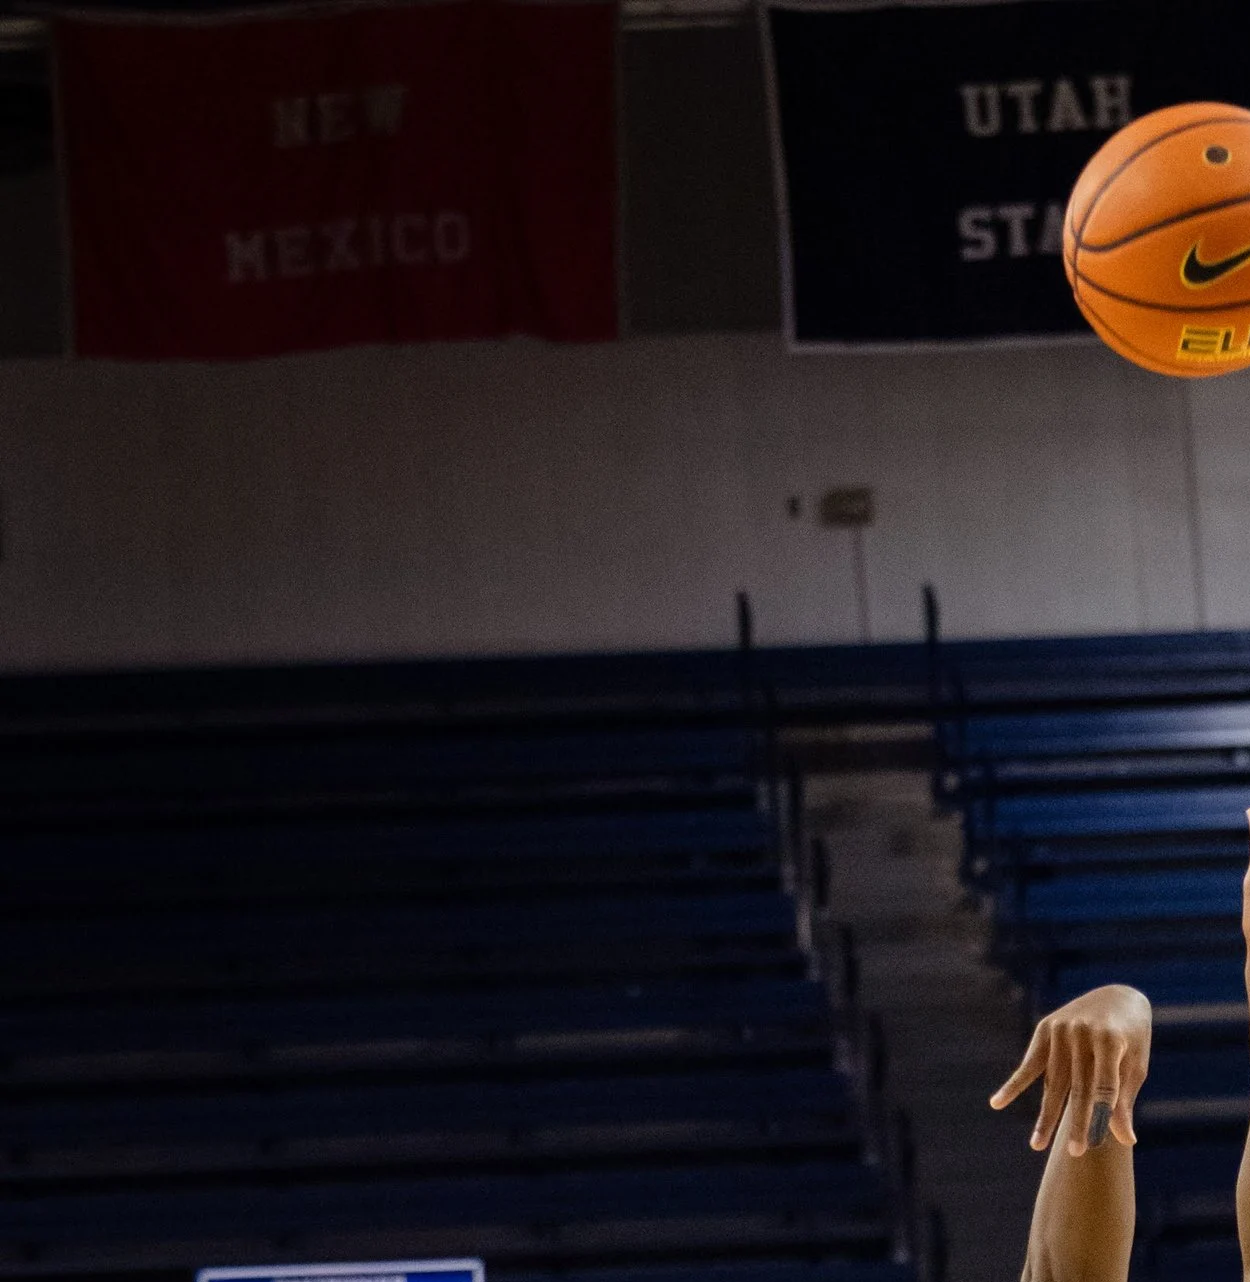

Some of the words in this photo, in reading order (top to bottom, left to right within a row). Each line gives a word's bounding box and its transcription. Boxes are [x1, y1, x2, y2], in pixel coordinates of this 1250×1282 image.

[271, 83, 408, 149] NEW
[958, 75, 1131, 138] UTAH
[223, 210, 472, 284] MEXICO
[957, 202, 1063, 262] STA
